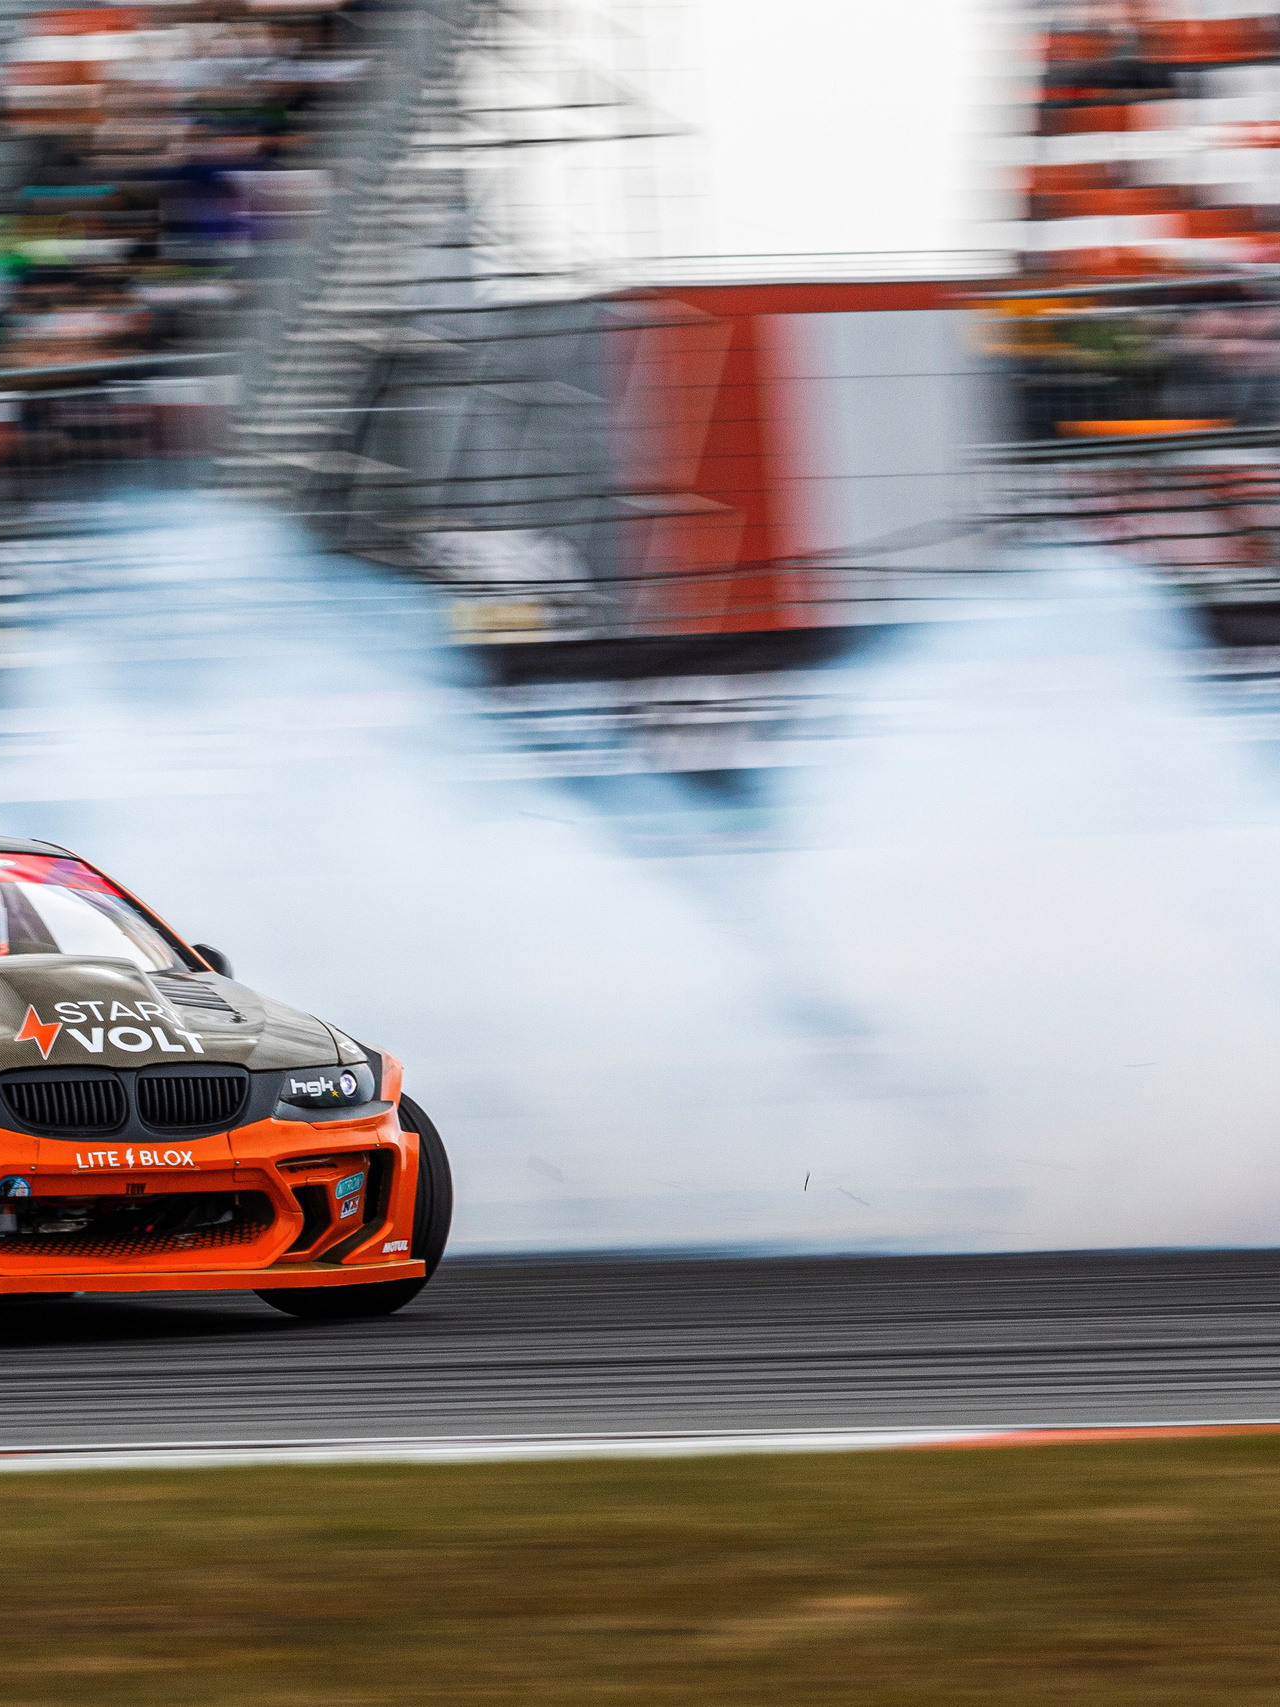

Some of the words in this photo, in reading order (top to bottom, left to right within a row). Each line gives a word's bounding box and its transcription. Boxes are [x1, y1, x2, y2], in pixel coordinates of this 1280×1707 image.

[54, 1001, 185, 1028] START
[66, 1027, 205, 1054] VOLT
[290, 1077, 335, 1097] hgk
[75, 1150, 121, 1169] LITE
[139, 1150, 195, 1167] BLOX
